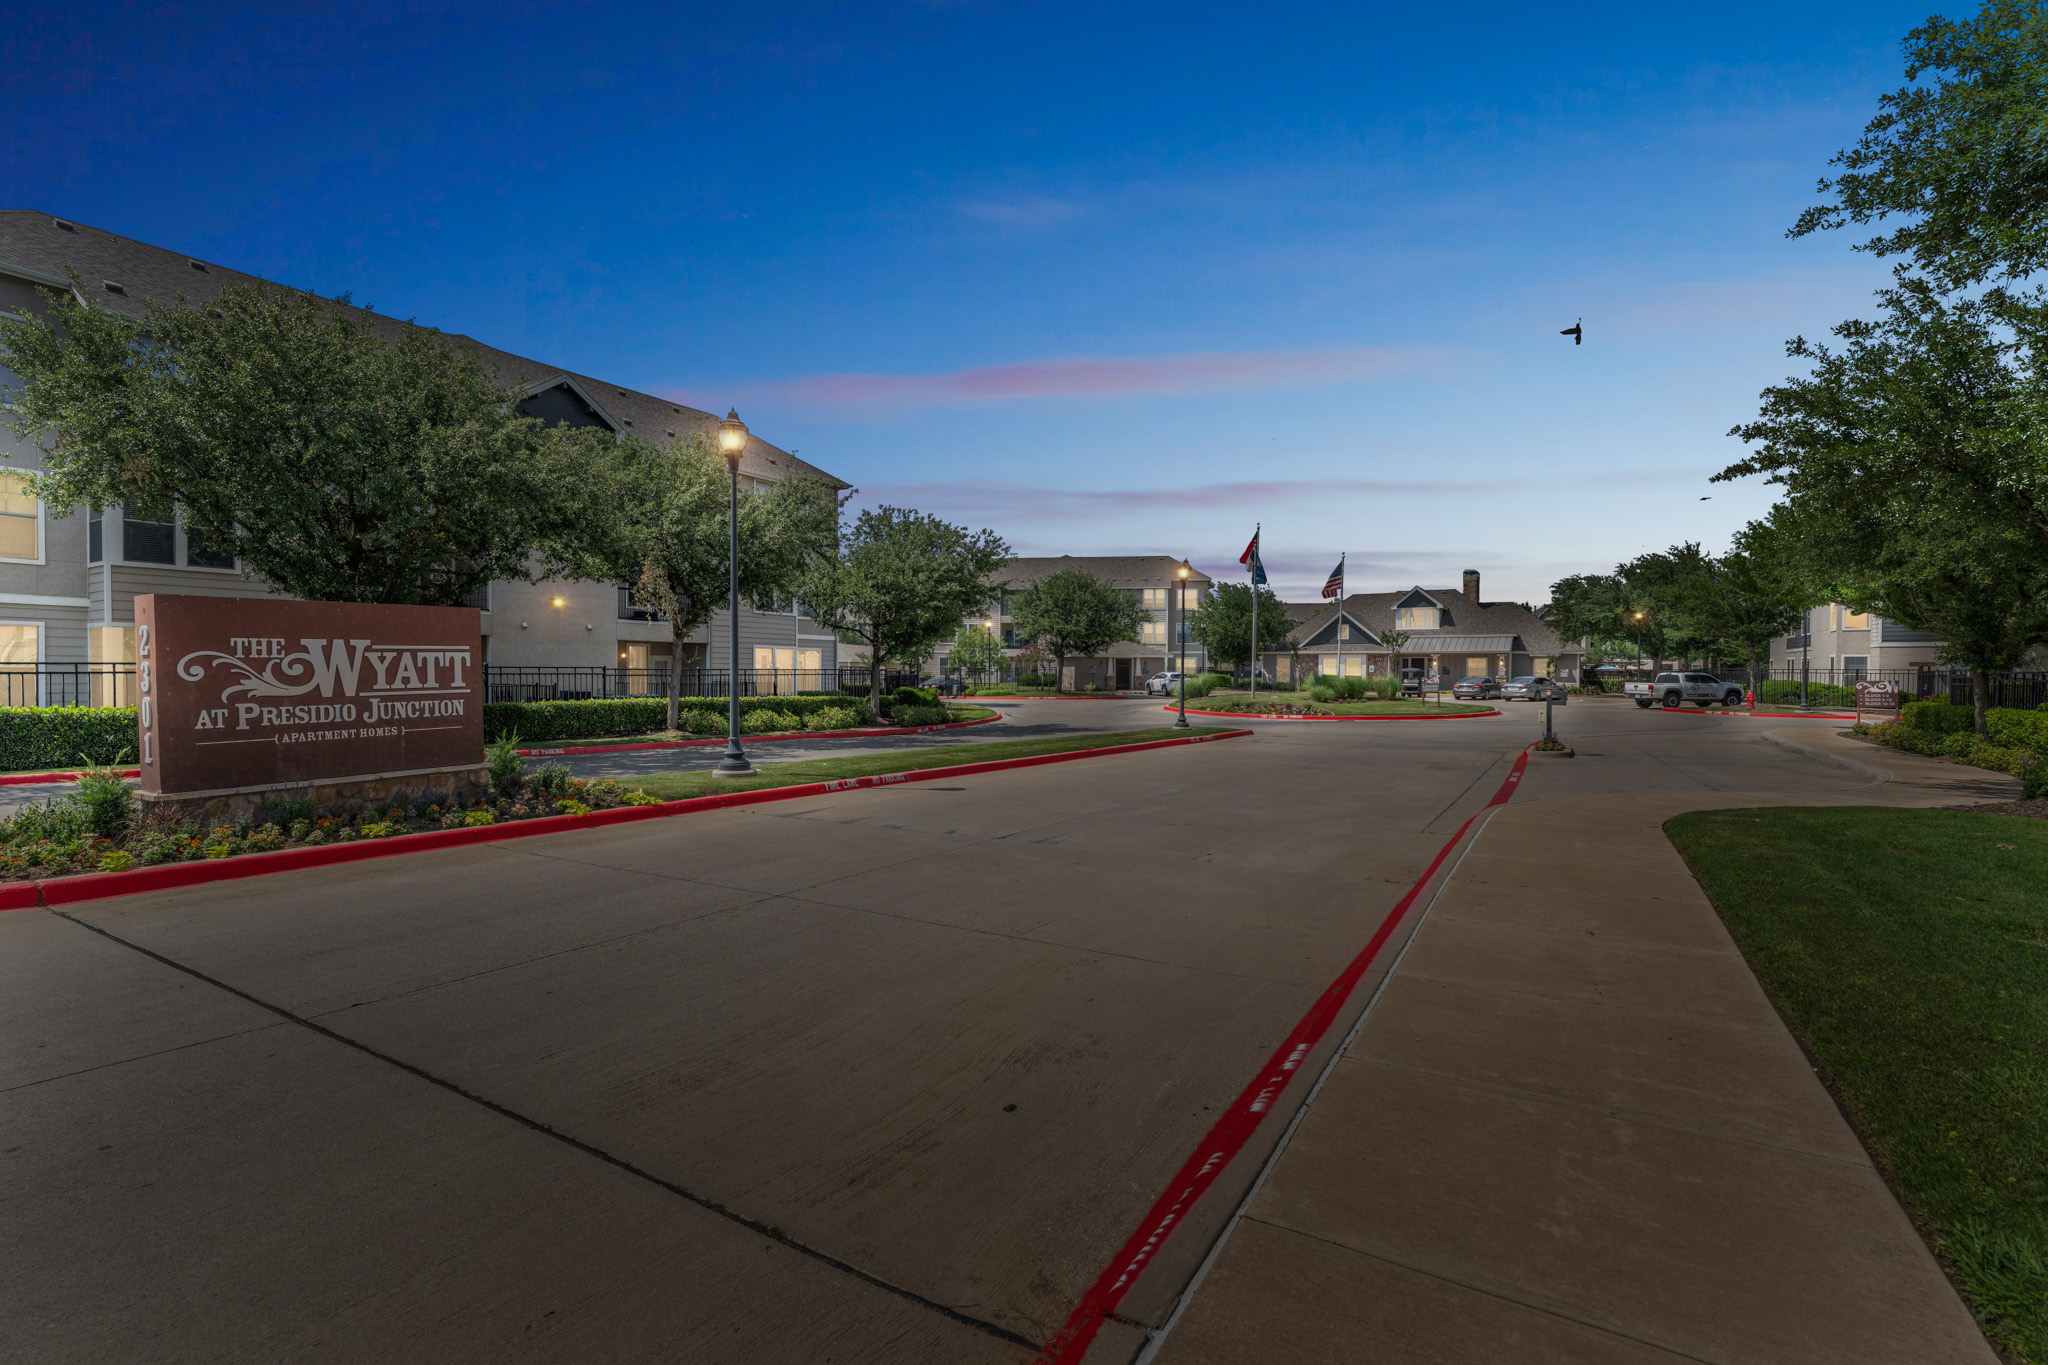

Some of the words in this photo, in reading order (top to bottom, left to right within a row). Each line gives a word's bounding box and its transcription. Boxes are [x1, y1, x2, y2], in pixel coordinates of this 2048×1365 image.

[230, 637, 285, 659] THE
[300, 638, 471, 698] WYATT
[138, 624, 153, 764] 2301
[194, 709, 228, 730] AT
[235, 703, 356, 730] PRESIDIO
[363, 698, 464, 723] JUNCTION
[282, 729, 357, 743] APARTMENT
[360, 726, 398, 738] HOMES
[825, 782, 841, 791] FIRE
[842, 780, 859, 788] LANE
